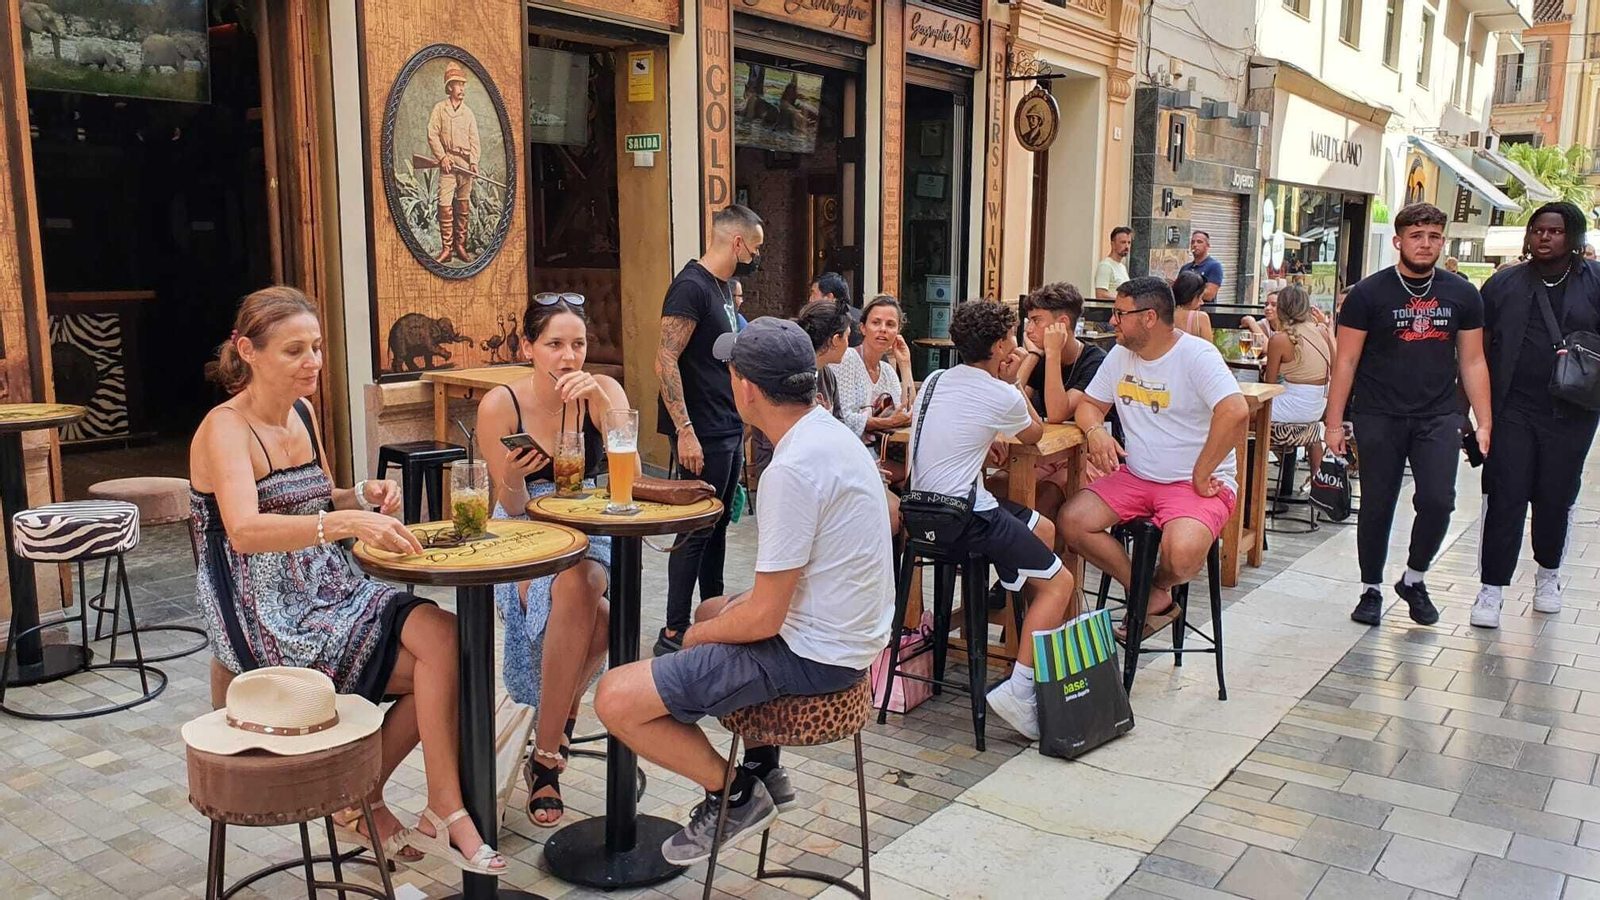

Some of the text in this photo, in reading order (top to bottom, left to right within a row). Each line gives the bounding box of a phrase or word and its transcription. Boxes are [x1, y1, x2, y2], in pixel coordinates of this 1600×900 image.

[705, 27, 729, 59] CUT
[992, 52, 1003, 167] BEERS
[628, 136, 659, 150] SALIDA
[1340, 140, 1363, 167] CANO
[1392, 307, 1452, 320] TOULOUSAIN
[1396, 320, 1411, 328] EST.
